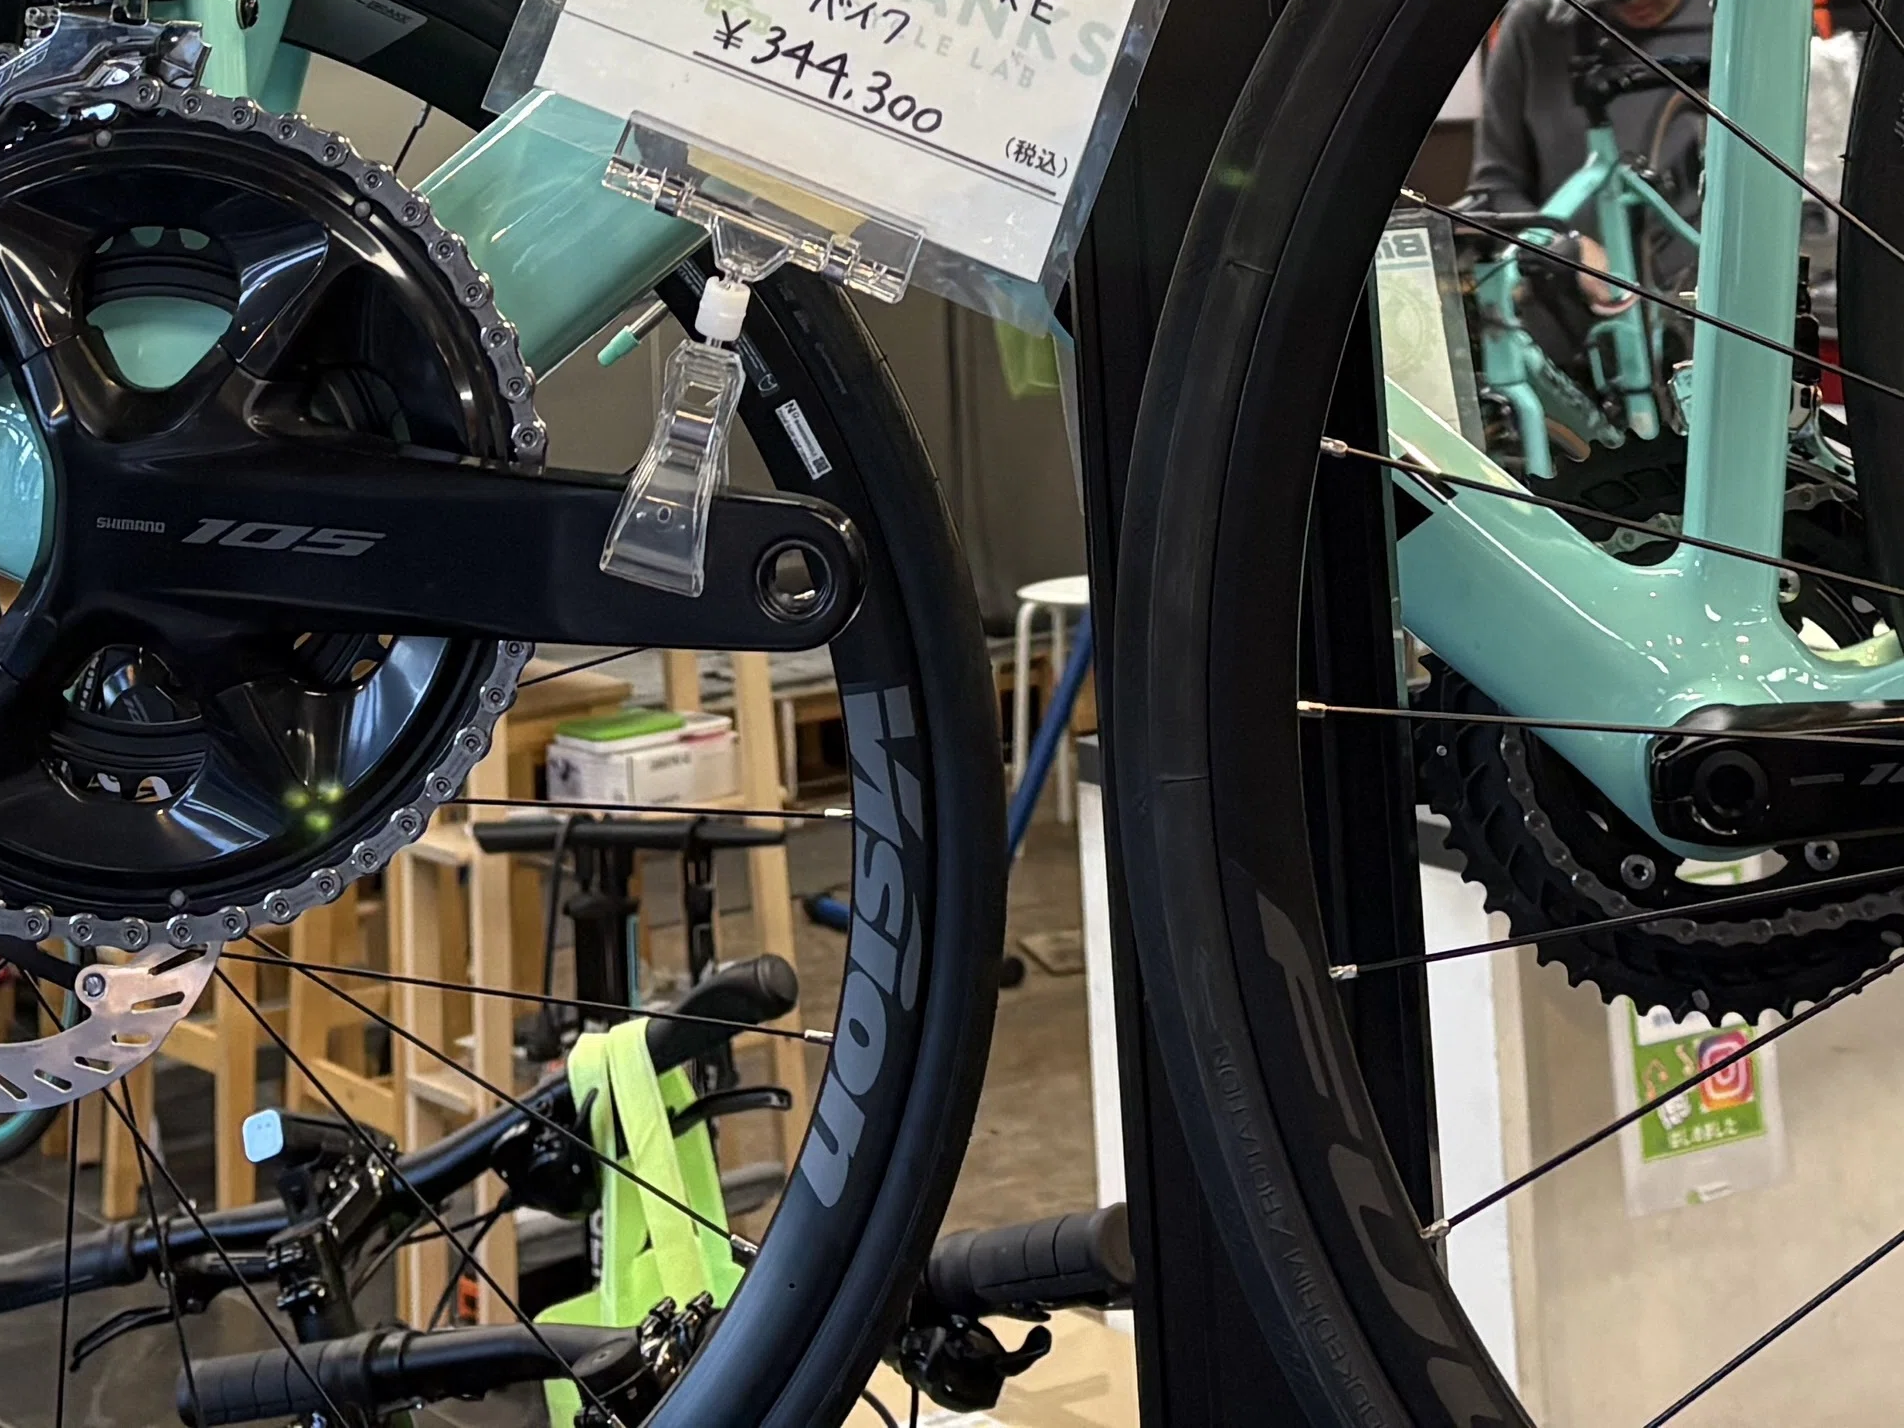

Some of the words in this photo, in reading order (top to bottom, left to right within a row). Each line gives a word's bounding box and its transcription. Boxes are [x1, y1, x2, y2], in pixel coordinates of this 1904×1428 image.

[969, 55, 1036, 90] LAB
[1005, 135, 1069, 180] (税込)
[95, 516, 166, 534] SHIMANO
[182, 518, 387, 557] 105
[799, 684, 925, 1209] Vision
